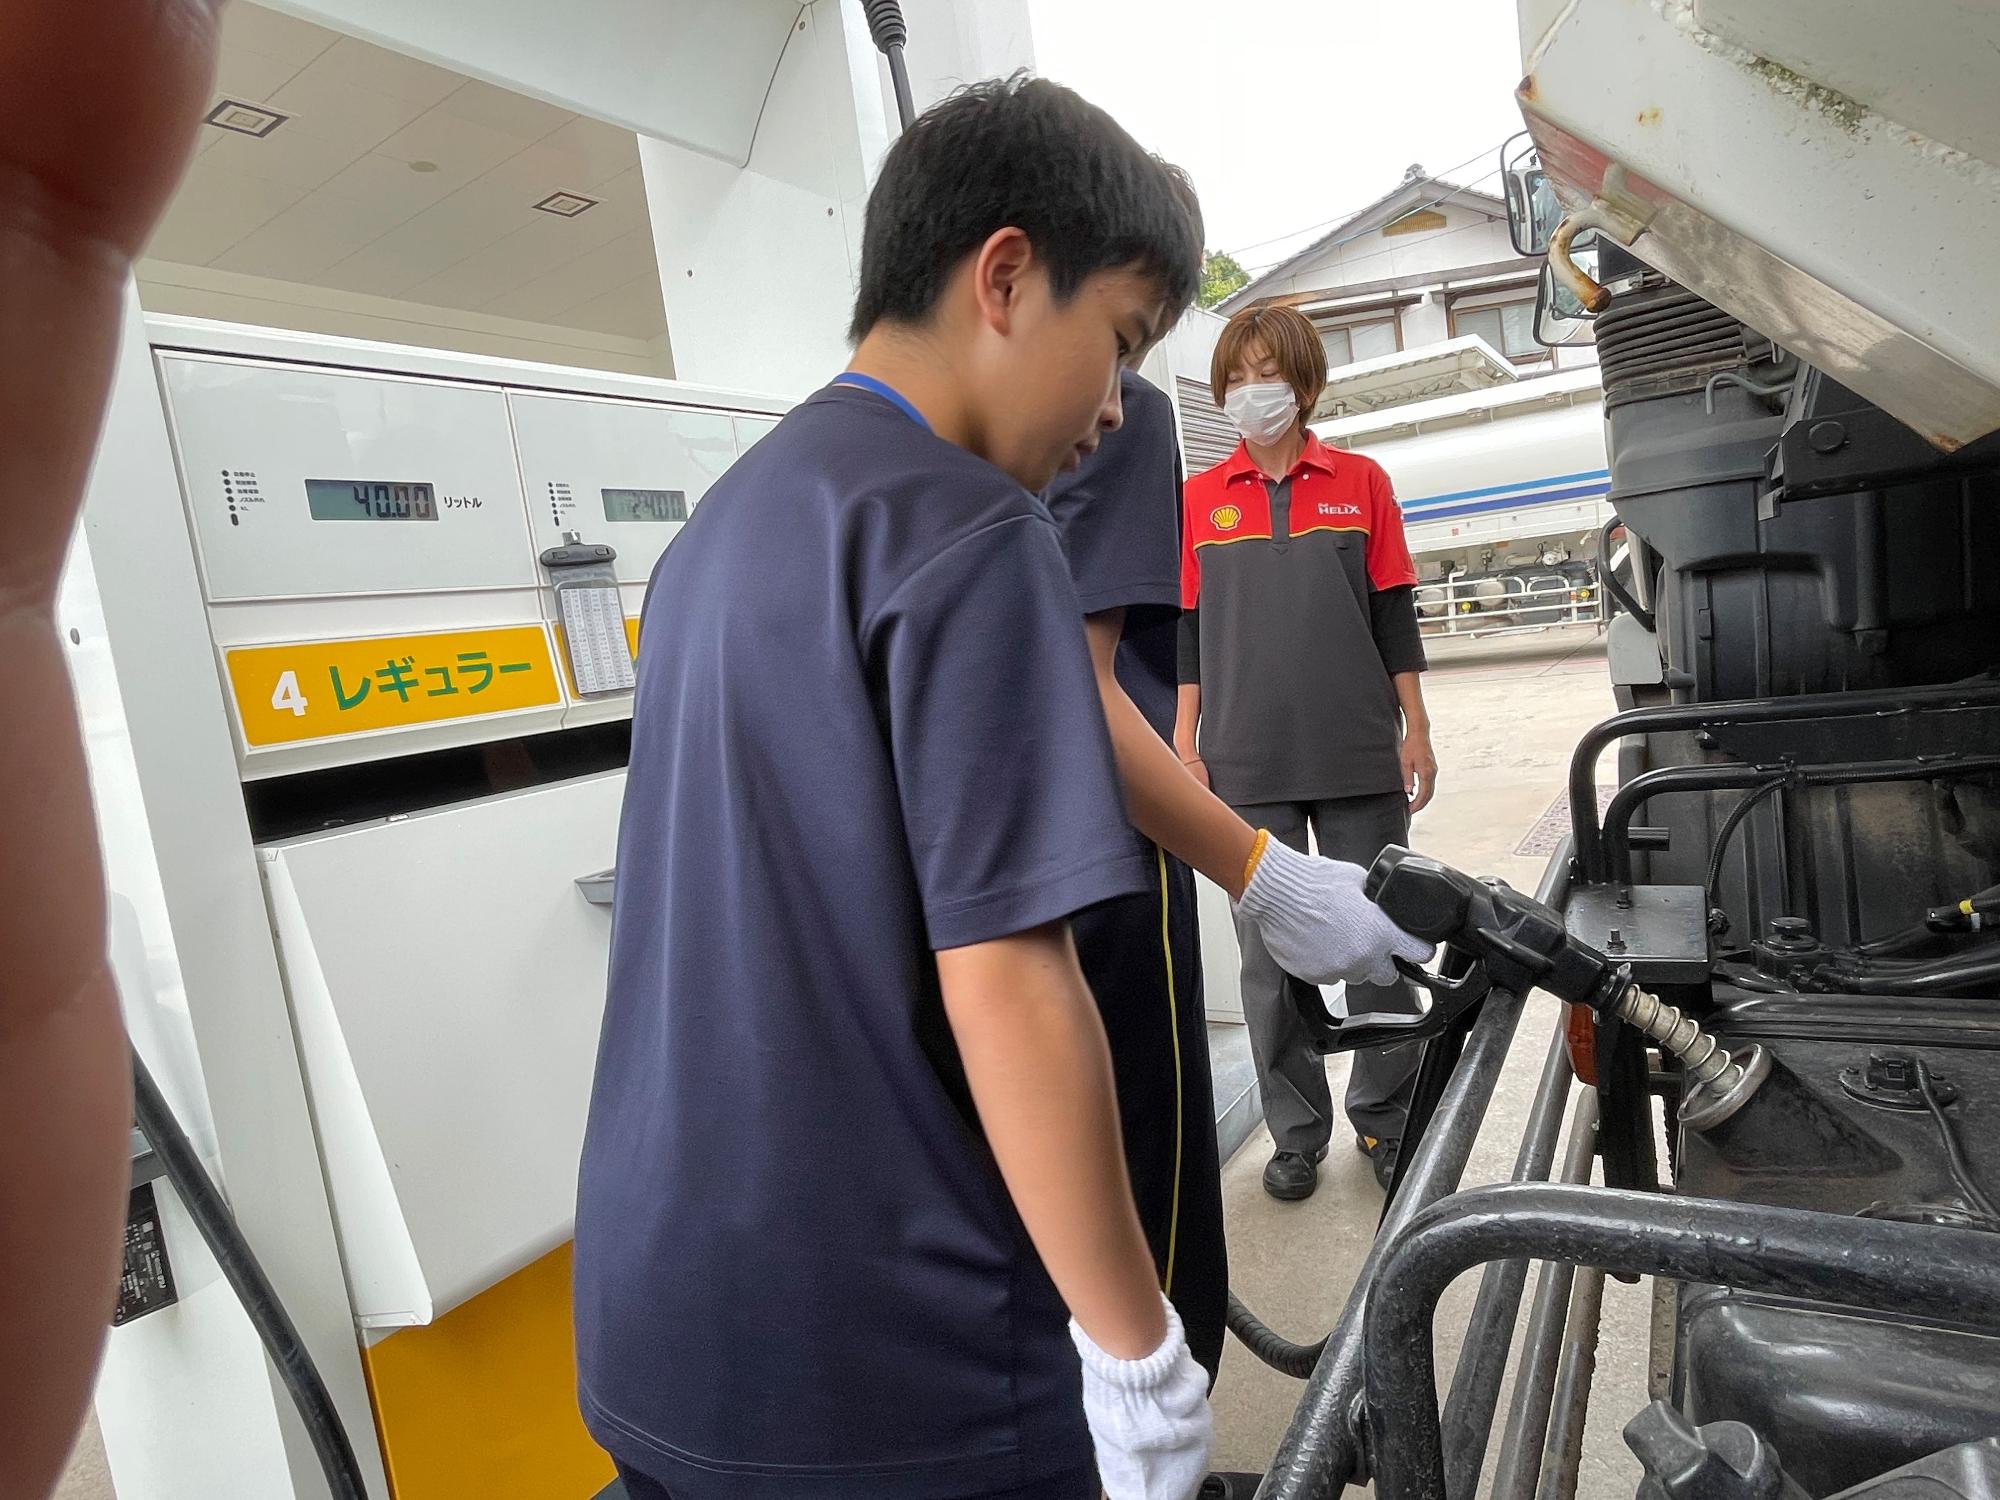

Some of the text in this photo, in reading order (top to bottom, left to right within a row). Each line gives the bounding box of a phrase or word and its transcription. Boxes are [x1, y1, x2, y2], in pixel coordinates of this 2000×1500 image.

[353, 485, 431, 518] 40.00
[443, 496, 482, 509] リットル
[1318, 503, 1362, 515] HELIX
[271, 652, 532, 717] 4 レギュラー
